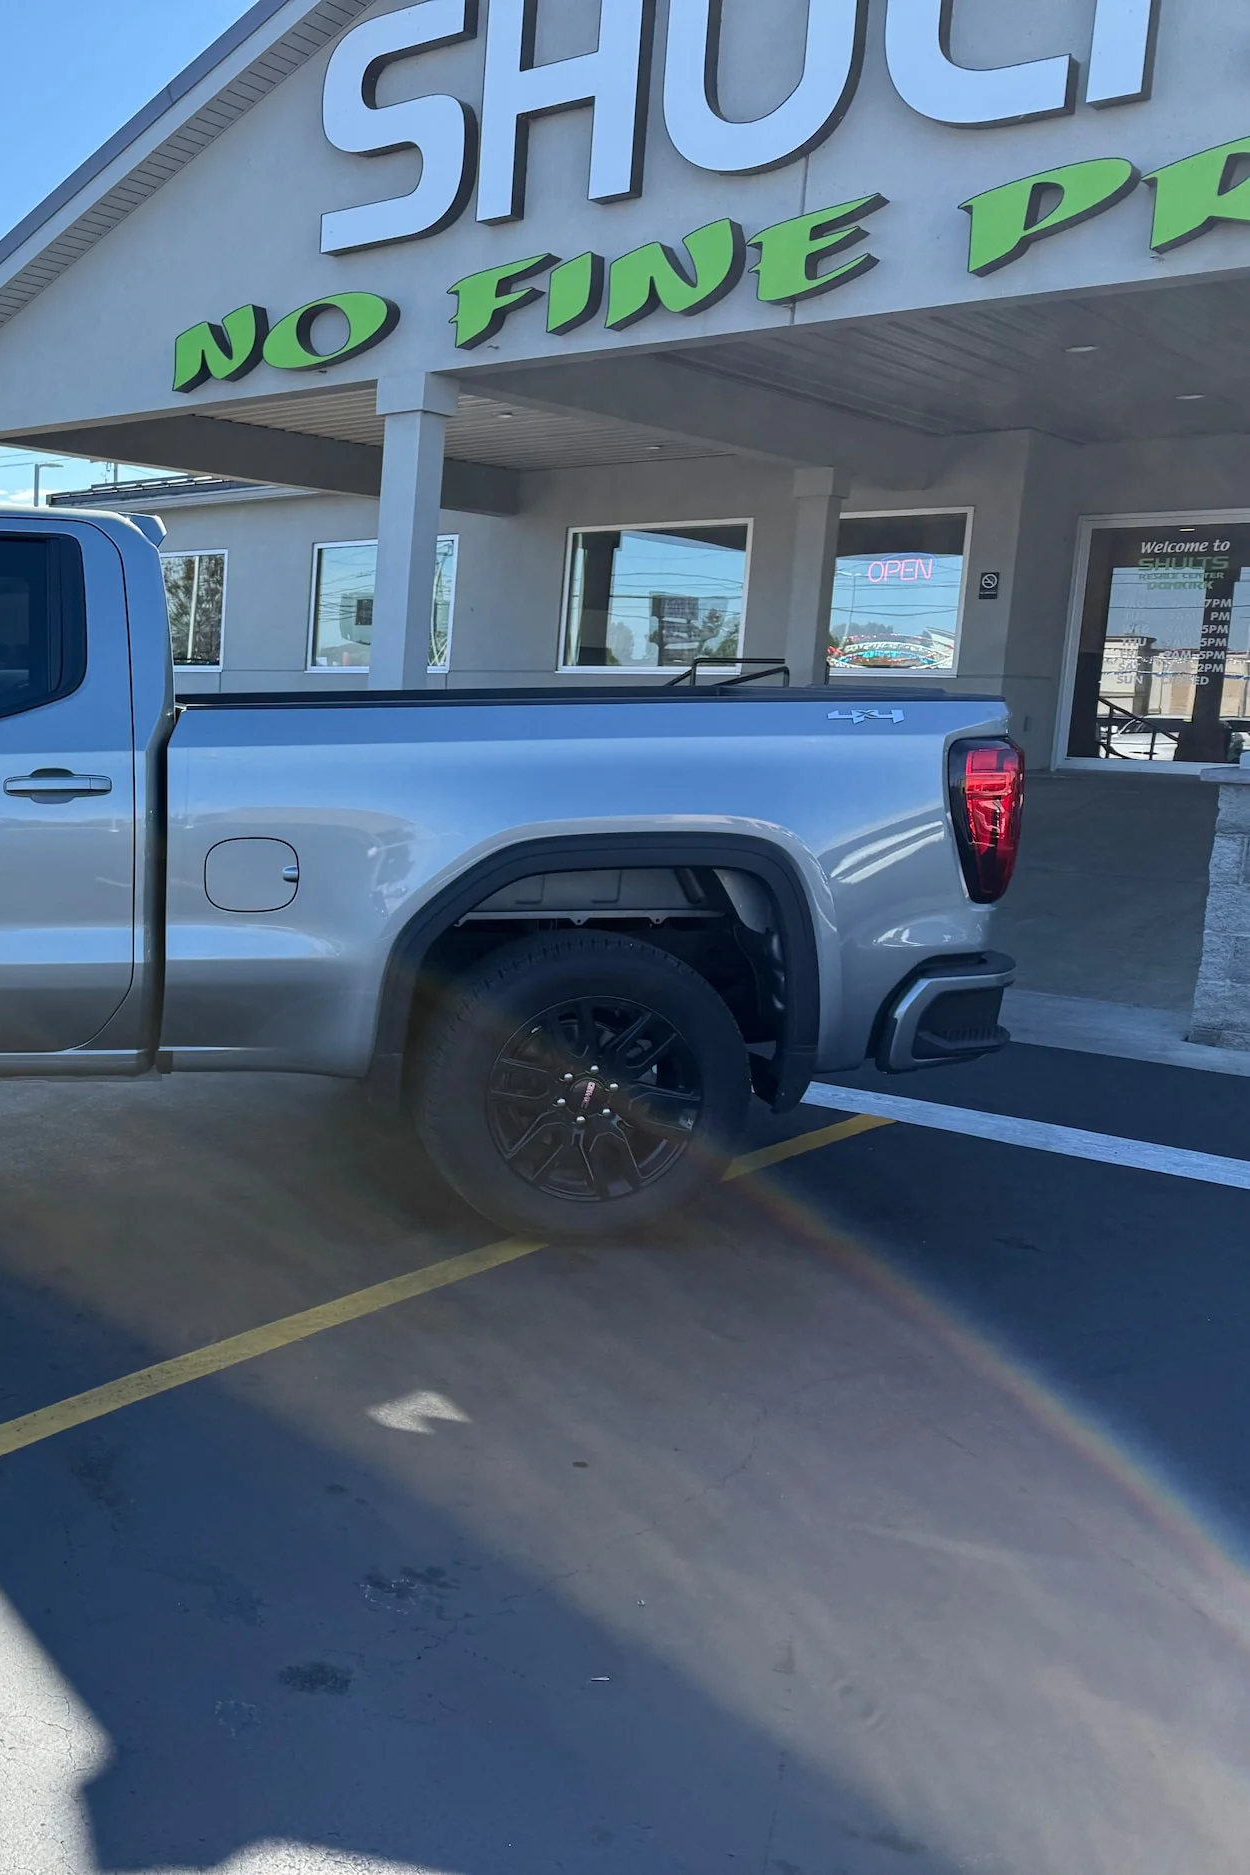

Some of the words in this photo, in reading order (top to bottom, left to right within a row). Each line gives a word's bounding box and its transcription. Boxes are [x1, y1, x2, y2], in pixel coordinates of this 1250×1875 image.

[172, 291, 400, 393] NO
[447, 192, 889, 350] FINE
[1140, 540, 1209, 554] Welcome
[1213, 539, 1231, 552] to
[1138, 555, 1230, 571] SHULTS
[868, 558, 933, 583] OPEN
[1182, 572, 1225, 580] CENTER
[1203, 598, 1232, 608] 7PM
[1201, 624, 1229, 634] 5PM
[1122, 638, 1147, 647] THU
[1199, 637, 1227, 647] 5PM
[1116, 675, 1144, 685] SUN
